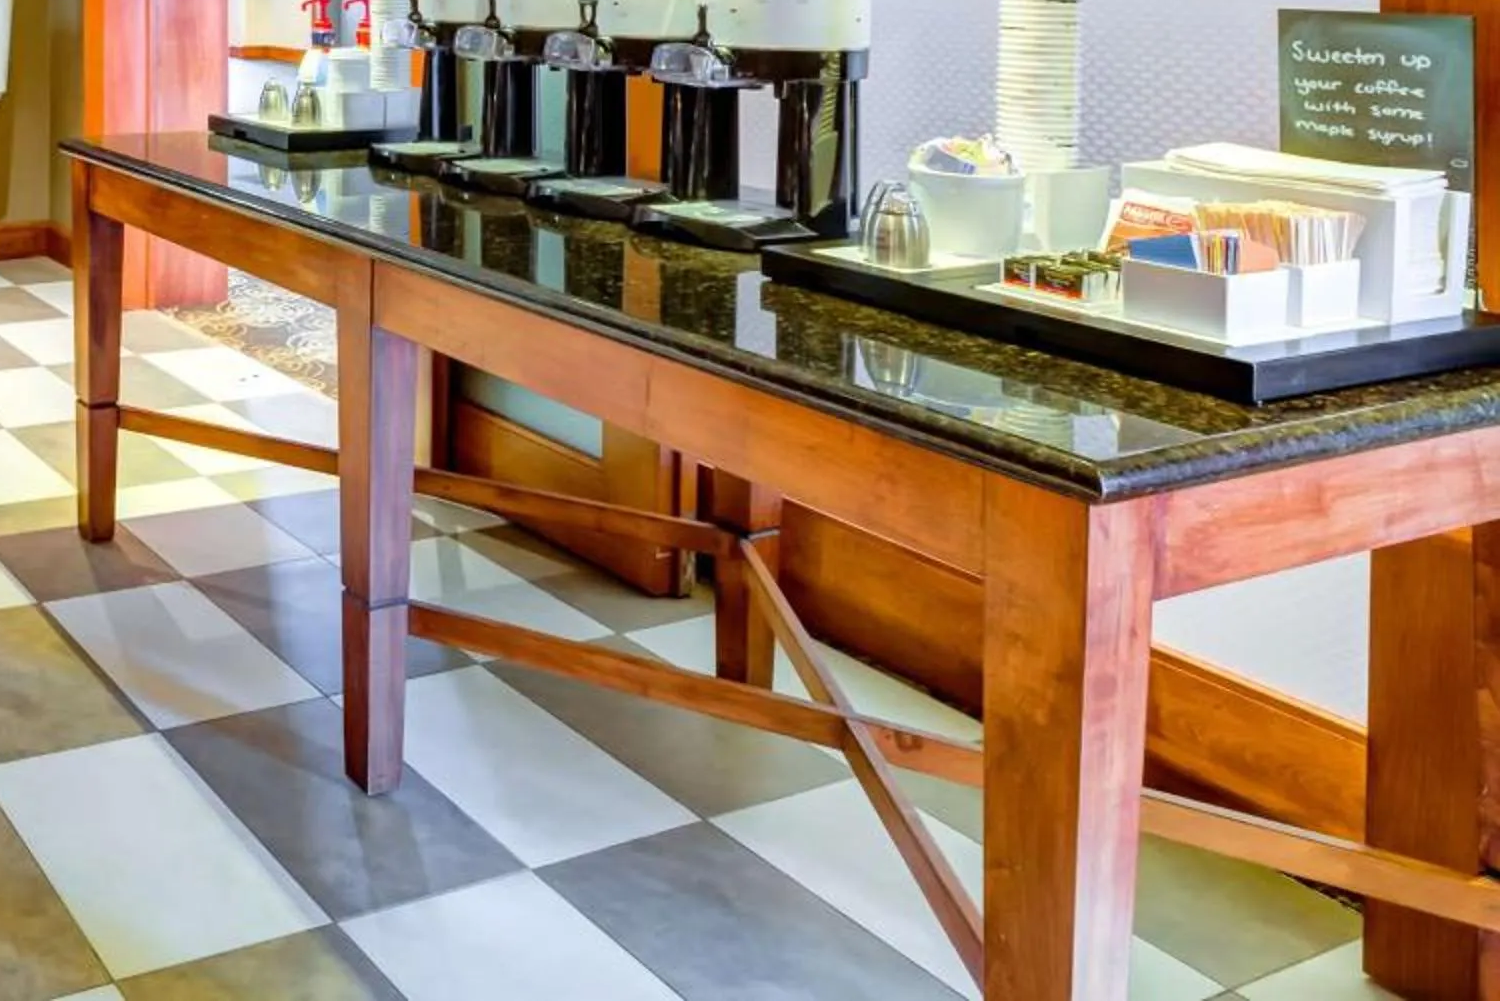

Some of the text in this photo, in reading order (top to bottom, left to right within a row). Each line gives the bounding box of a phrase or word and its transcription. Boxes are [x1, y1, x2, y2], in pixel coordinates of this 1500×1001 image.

[1291, 40, 1432, 70] Sweeten up
[1294, 77, 1426, 99] your coffee
[1304, 100, 1427, 120] with some
[1295, 119, 1355, 138] maple
